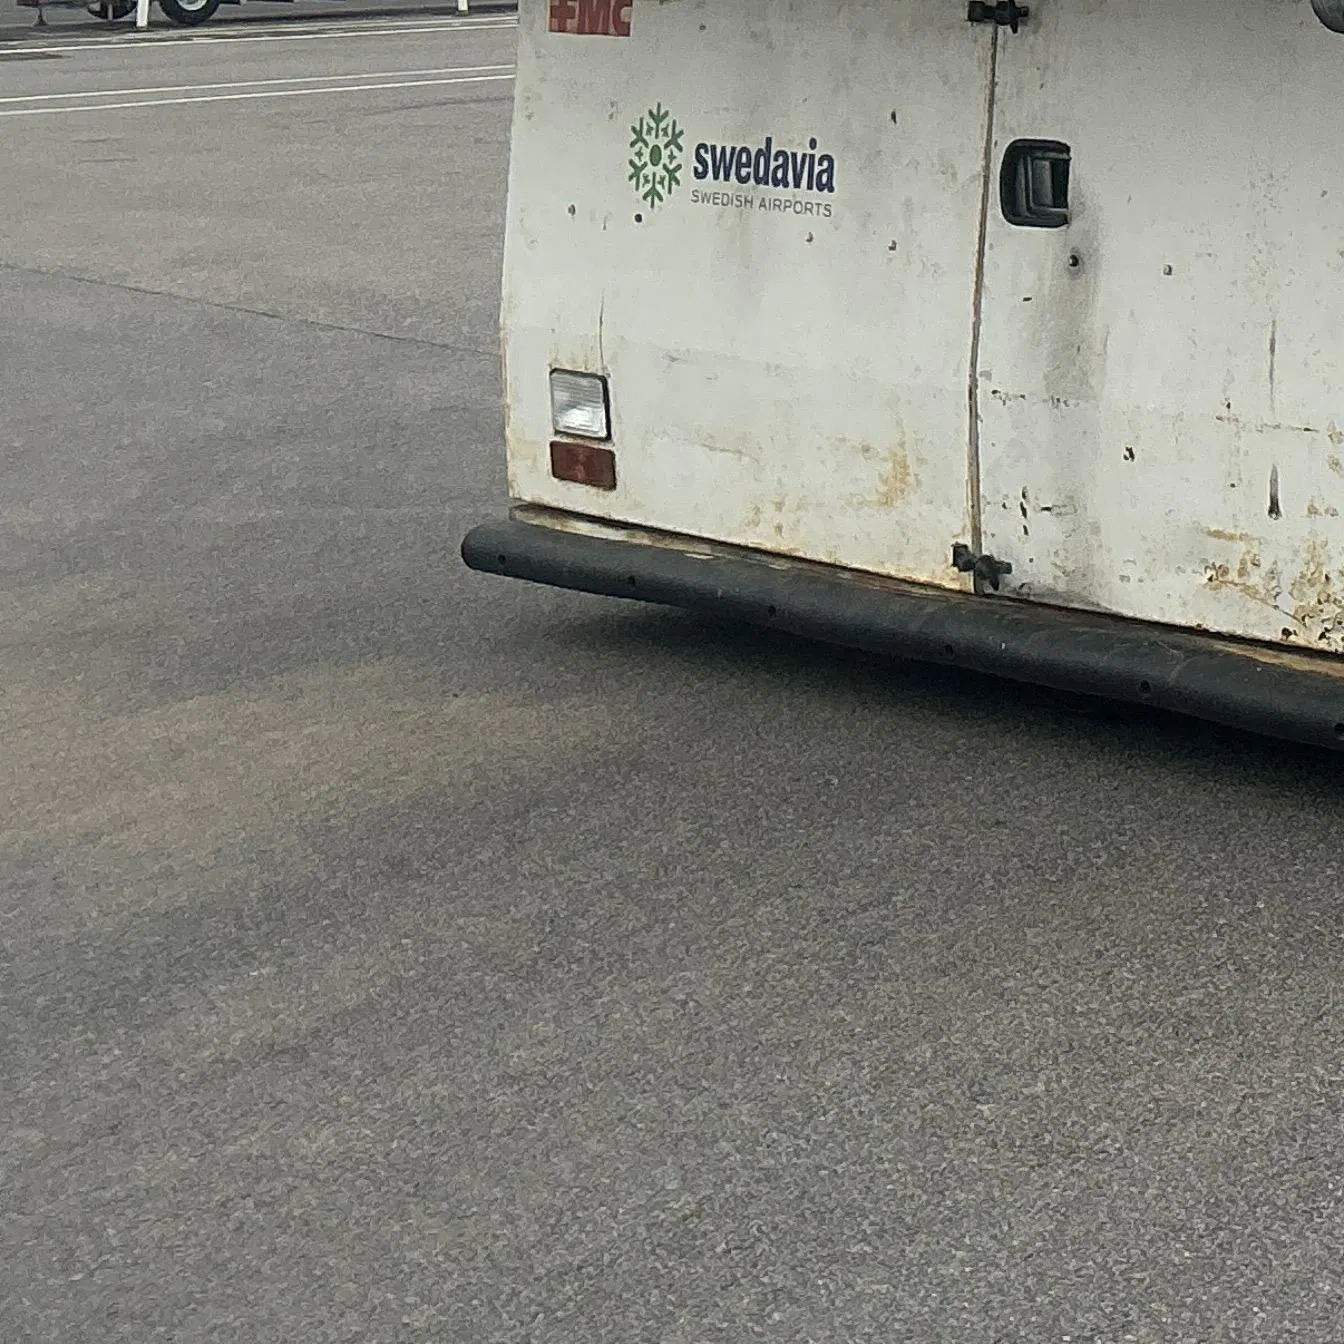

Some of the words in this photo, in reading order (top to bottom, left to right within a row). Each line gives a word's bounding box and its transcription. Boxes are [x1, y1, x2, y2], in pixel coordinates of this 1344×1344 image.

[693, 136, 835, 193] swedavia
[691, 188, 753, 209] SWEDISH
[758, 197, 832, 218] AIRPORTS
